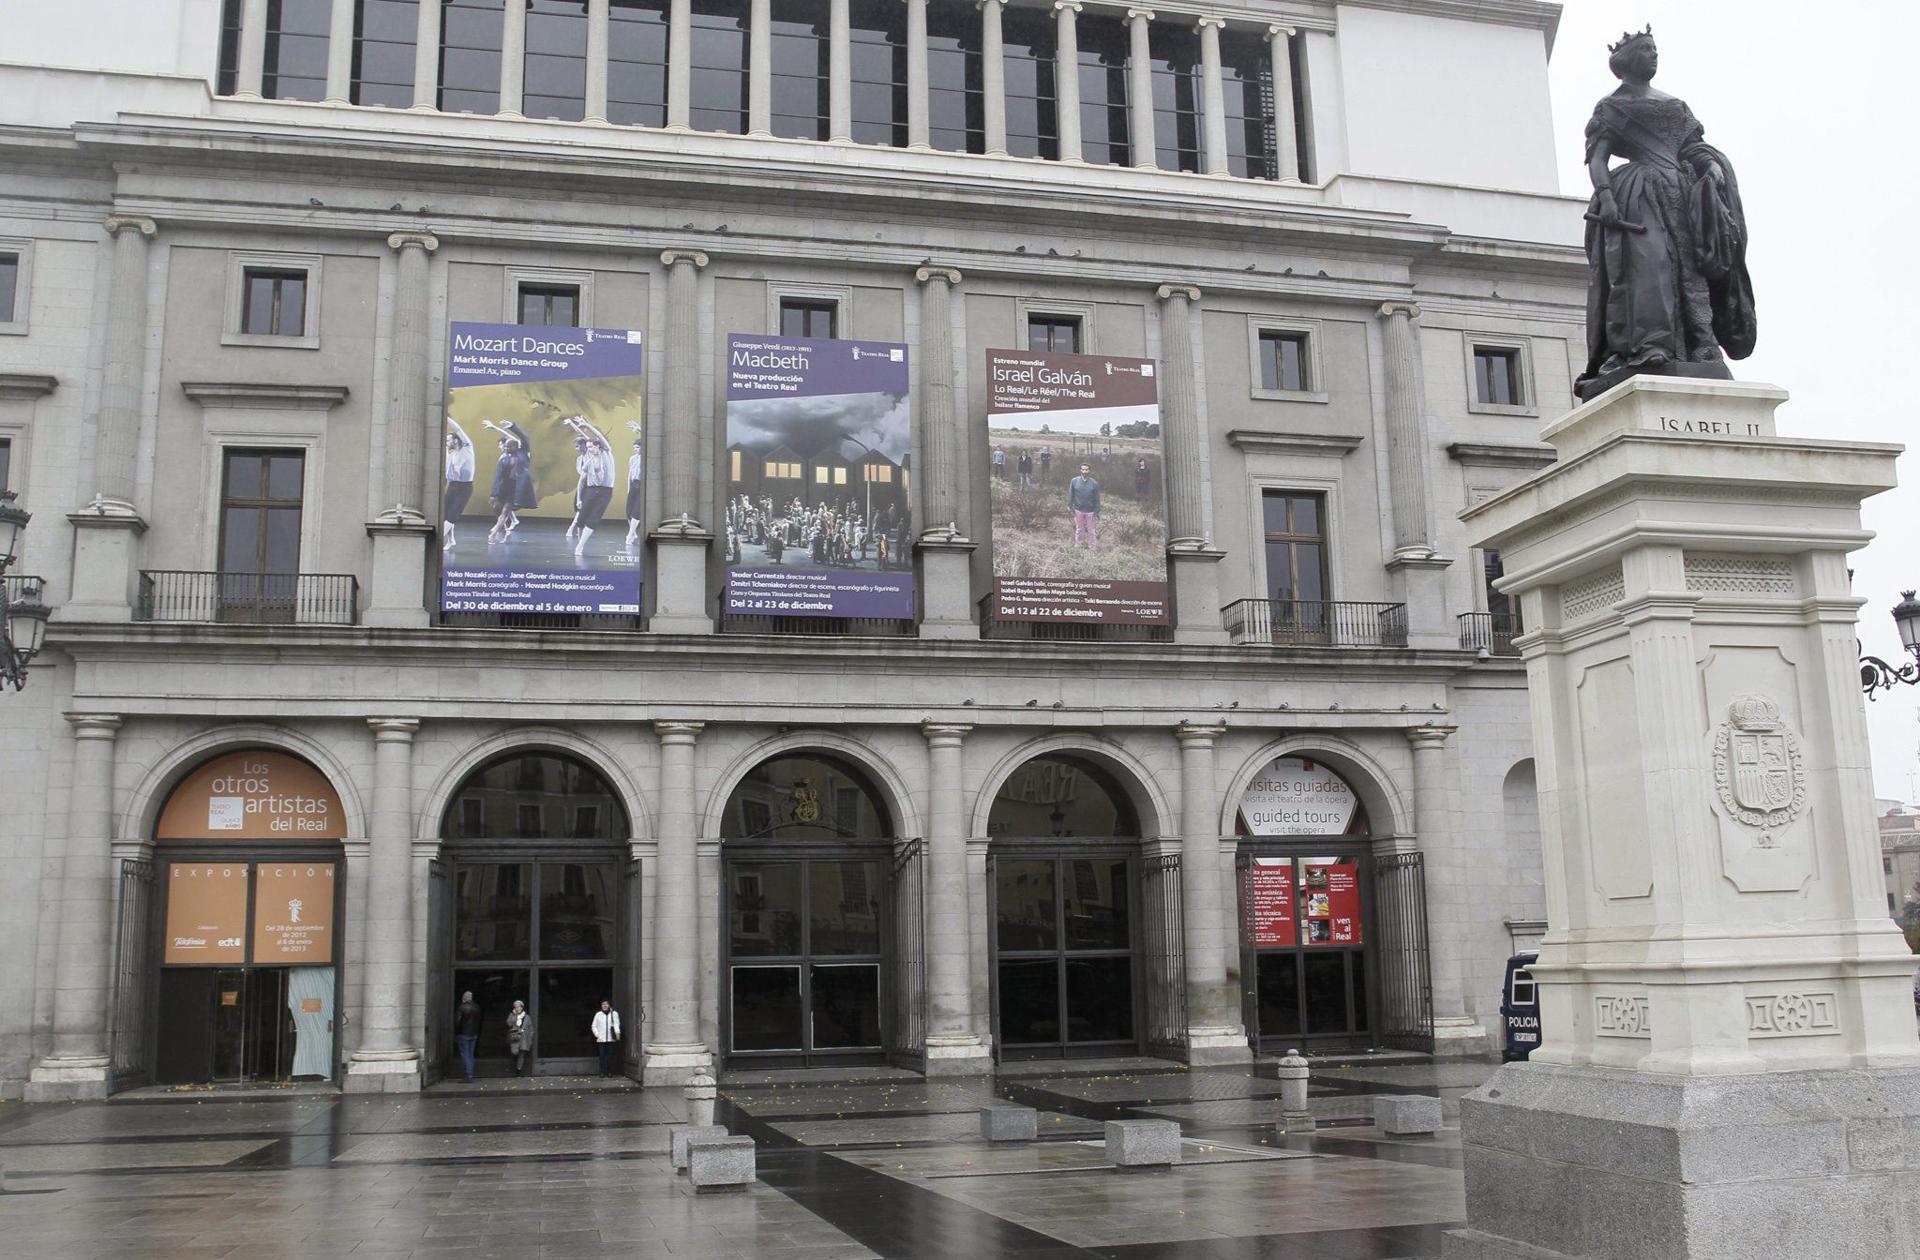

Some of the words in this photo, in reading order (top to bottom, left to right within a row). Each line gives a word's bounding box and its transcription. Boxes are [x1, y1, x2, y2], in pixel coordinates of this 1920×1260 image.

[455, 334, 518, 353] Mozart
[523, 337, 584, 356] Dances
[732, 341, 762, 350] Giuseppe
[453, 355, 477, 364] Mark
[479, 356, 509, 366] Morris
[511, 357, 539, 367] Dance
[541, 359, 568, 369] Group
[732, 351, 809, 370] Macbeth
[453, 366, 486, 375] Emanuel
[487, 367, 499, 376] Ax,
[500, 369, 521, 377] piano
[993, 365, 1034, 382] Israel
[1038, 368, 1092, 386] Galván
[732, 372, 758, 380] Nueva
[759, 374, 803, 383] producción
[744, 381, 752, 389] el
[753, 382, 779, 390] Teatro
[780, 383, 797, 391] Real
[994, 385, 1005, 393] Lo
[1078, 389, 1095, 398] Real
[526, 572, 548, 580] Glover
[753, 572, 785, 580] Currentzis
[552, 583, 579, 591] Hodgkin
[446, 601, 461, 610] Del
[463, 601, 476, 610] 30
[477, 602, 489, 610] de
[490, 602, 534, 611] diciembre
[535, 602, 544, 611] al
[545, 603, 552, 611] 5
[553, 603, 565, 611] de
[566, 604, 592, 612] enero
[731, 600, 746, 608] Del
[754, 600, 763, 608] al
[778, 601, 789, 609] de
[790, 601, 833, 610] diciembre
[1017, 607, 1028, 615] 12
[1051, 608, 1062, 616] de
[1063, 608, 1103, 617] diciembre
[244, 761, 269, 774] Los
[212, 775, 270, 793] otros
[1246, 778, 1289, 792] visitas
[1294, 779, 1347, 796] guiadas
[245, 793, 328, 814] artistas
[1277, 796, 1302, 804] teatro
[1253, 809, 1299, 826] guided
[1304, 811, 1340, 823] tours
[270, 816, 292, 831] del
[297, 817, 327, 831] Real
[1270, 825, 1285, 834] visit
[1287, 825, 1301, 834] the
[1303, 826, 1325, 835] opera
[1344, 924, 1351, 932] al
[1335, 932, 1352, 940] Real
[1508, 1016, 1539, 1028] POLICIA
